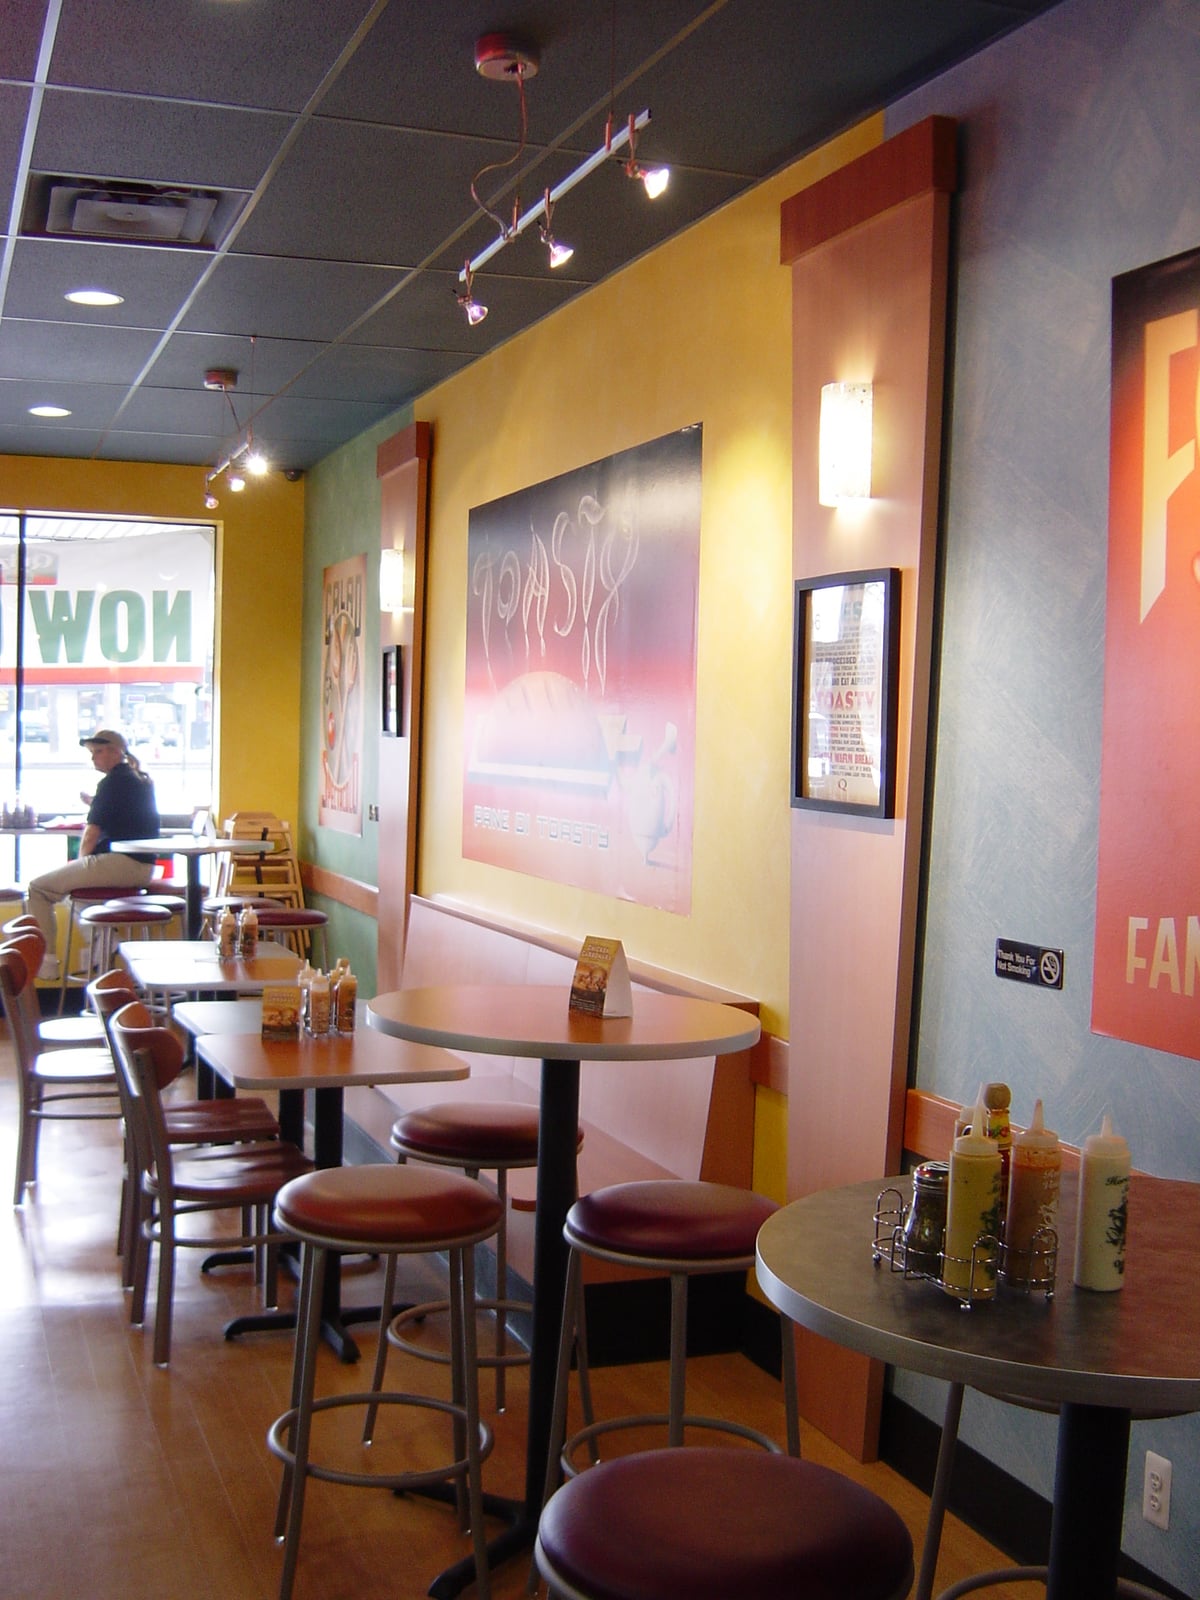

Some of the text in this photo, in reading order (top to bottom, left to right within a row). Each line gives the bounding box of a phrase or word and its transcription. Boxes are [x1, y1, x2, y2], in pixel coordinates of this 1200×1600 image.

[473, 490, 640, 697] TOASTY
[815, 690, 875, 711] TOASTY
[536, 815, 609, 851] TOASTY
[1007, 963, 1031, 978] Smoking
[1025, 955, 1035, 965] For
